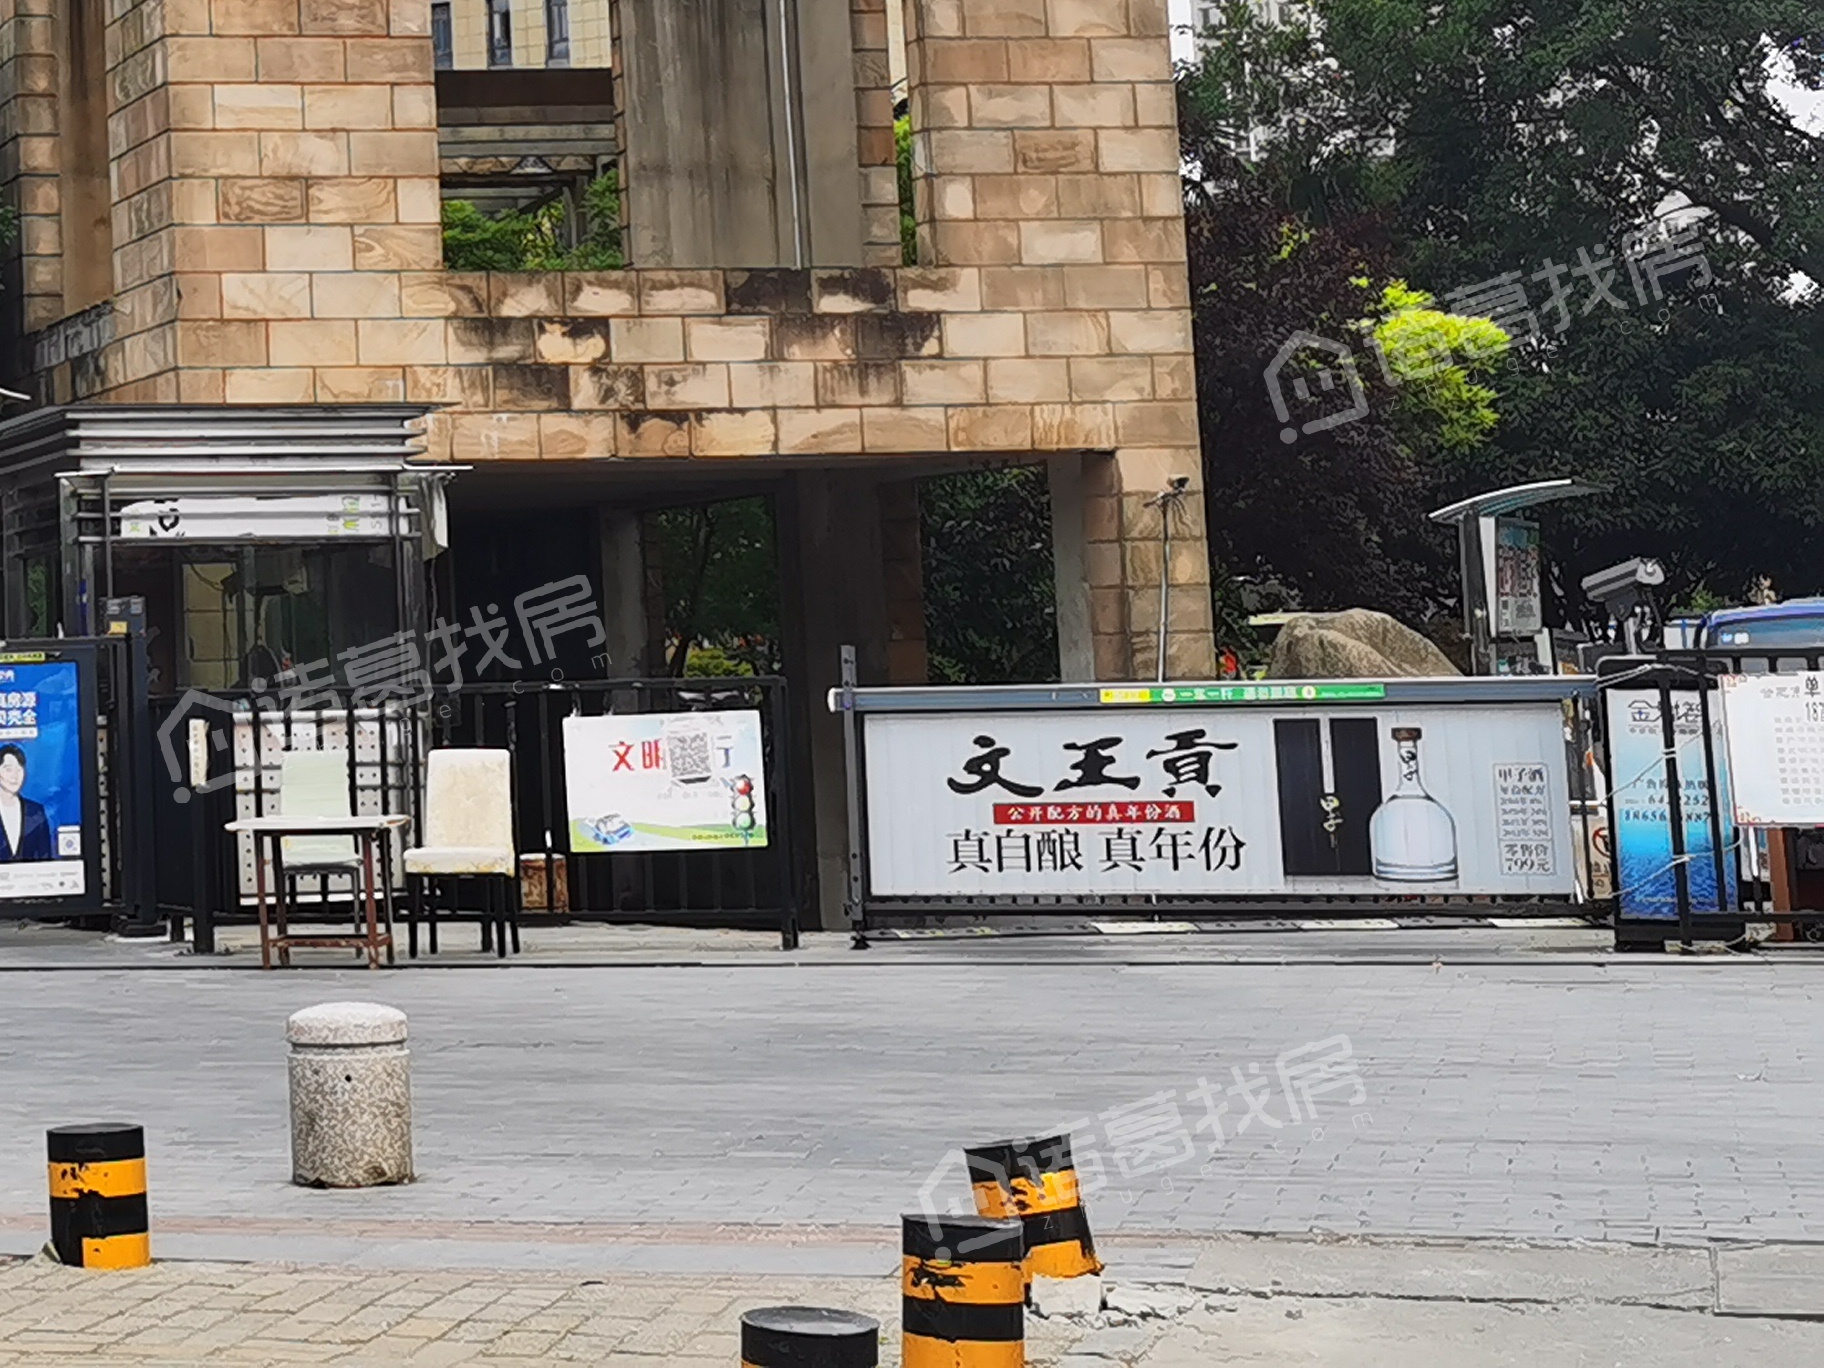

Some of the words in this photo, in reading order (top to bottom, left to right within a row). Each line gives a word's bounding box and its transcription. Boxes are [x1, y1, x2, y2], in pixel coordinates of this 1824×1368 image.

[1008, 804, 1183, 822] 公开配方的真年份酒
[946, 827, 1085, 874] 真自酿
[1098, 826, 1247, 873] 真年份
